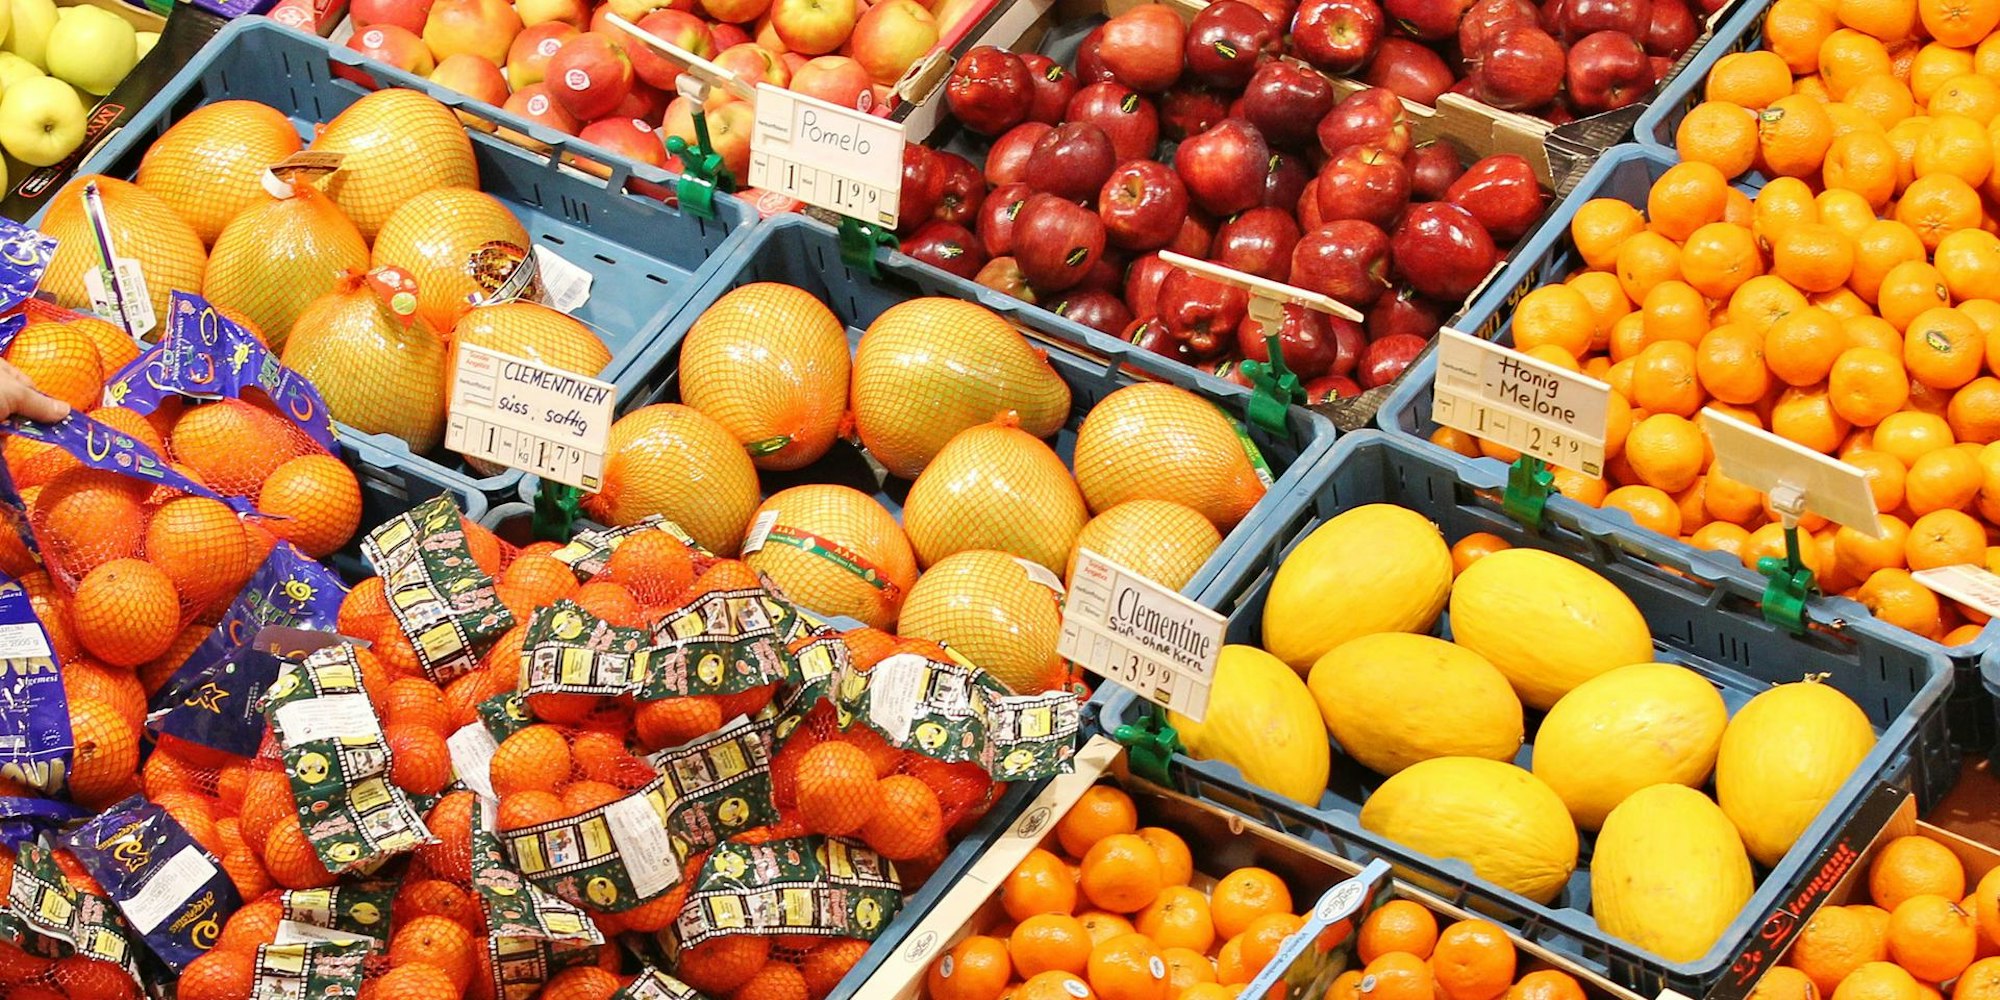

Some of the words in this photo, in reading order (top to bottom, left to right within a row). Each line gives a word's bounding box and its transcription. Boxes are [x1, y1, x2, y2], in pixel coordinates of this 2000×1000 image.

[801, 110, 870, 155] Pomelo
[787, 164, 795, 190] 1
[835, 179, 877, 208] 1.99
[503, 361, 609, 405] CLEMENTINEN
[1498, 356, 1559, 399] Honig
[544, 409, 588, 437] saftig
[1476, 408, 1486, 432] 1
[486, 426, 495, 454] 1
[1529, 427, 1579, 457] 2.49
[518, 451, 530, 464] kg
[536, 441, 580, 472] 1.79
[1118, 587, 1210, 660] Clementine
[1172, 650, 1204, 673] Kern
[1761, 842, 1850, 950] Diamant
